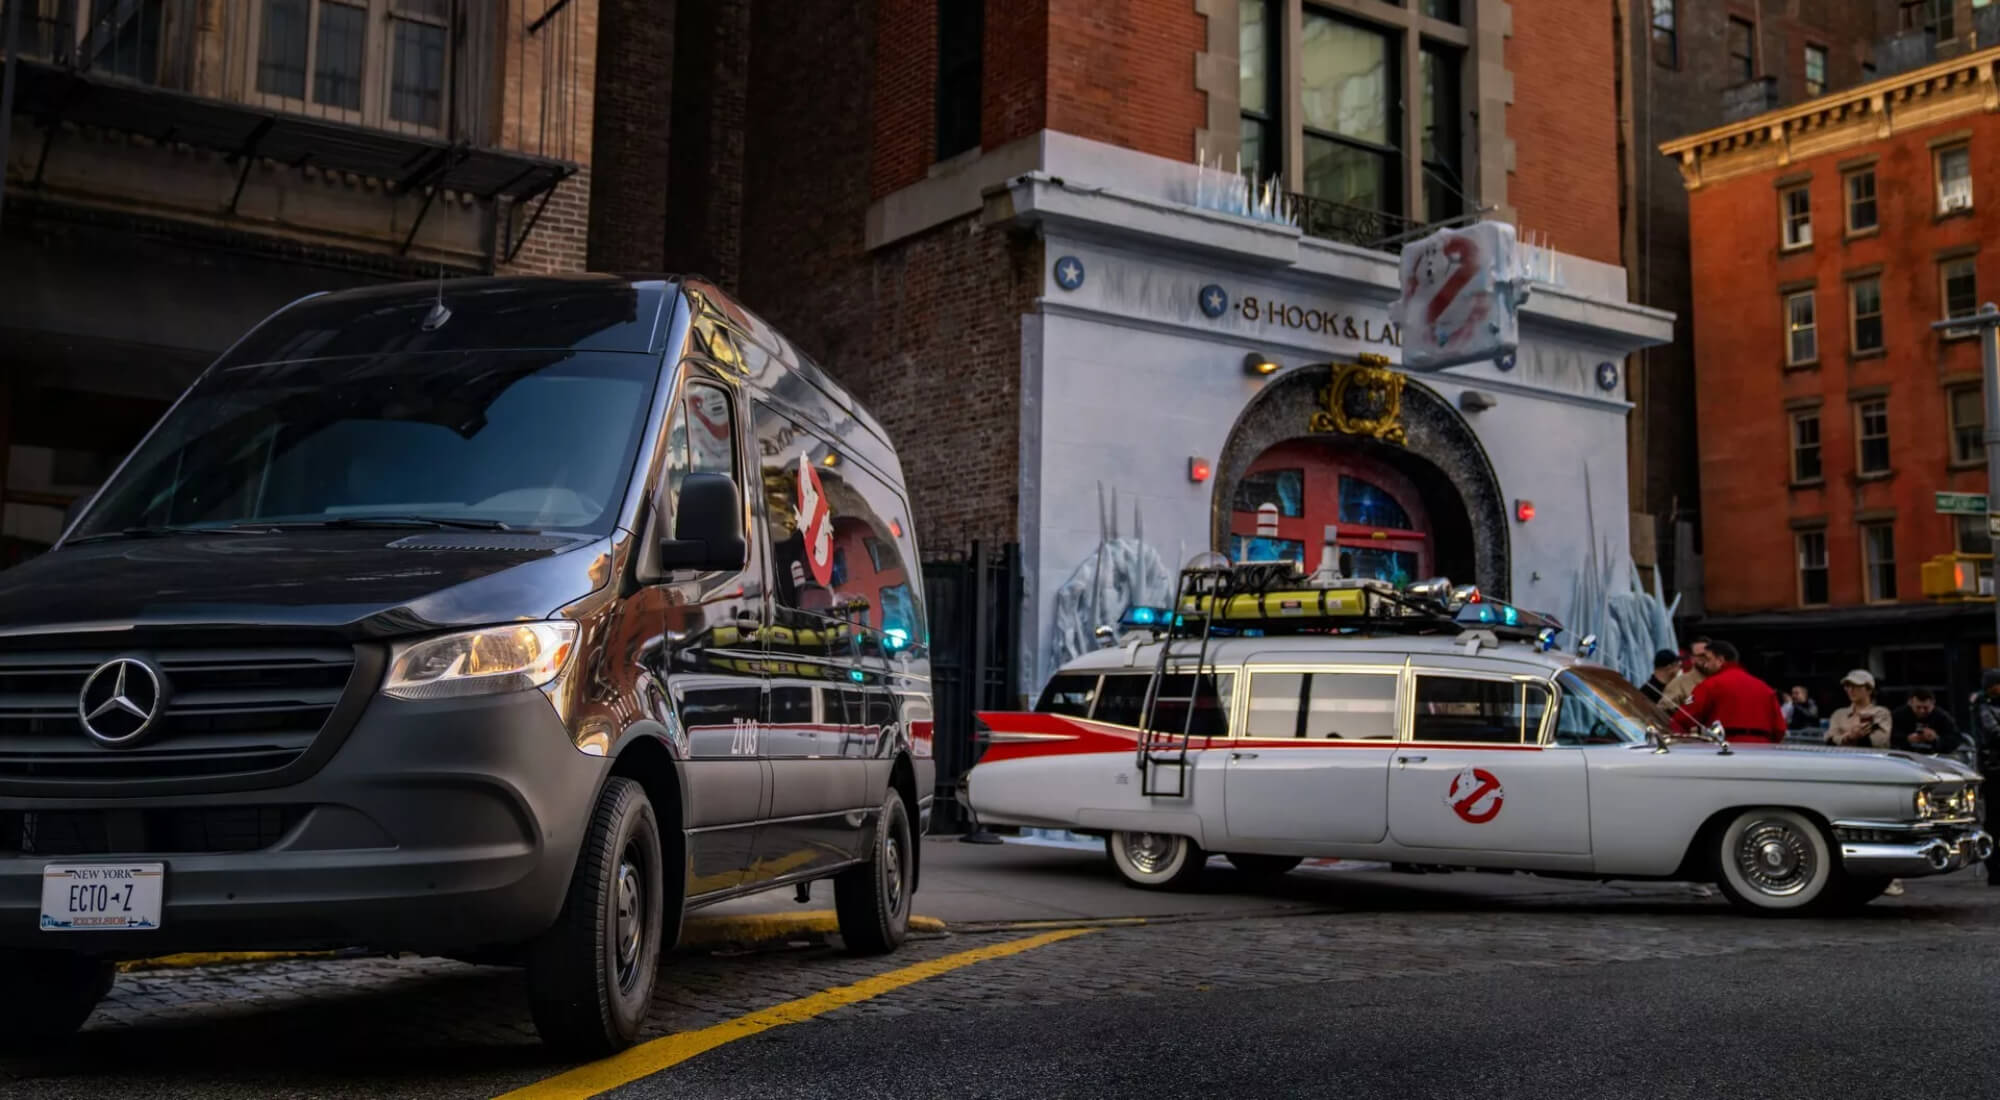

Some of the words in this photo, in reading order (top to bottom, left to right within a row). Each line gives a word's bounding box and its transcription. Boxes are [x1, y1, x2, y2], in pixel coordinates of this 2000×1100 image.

[1268, 301, 1338, 337] HOOK
[1343, 315, 1360, 340] &
[73, 870, 100, 879] NEW
[102, 869, 133, 879] YORK
